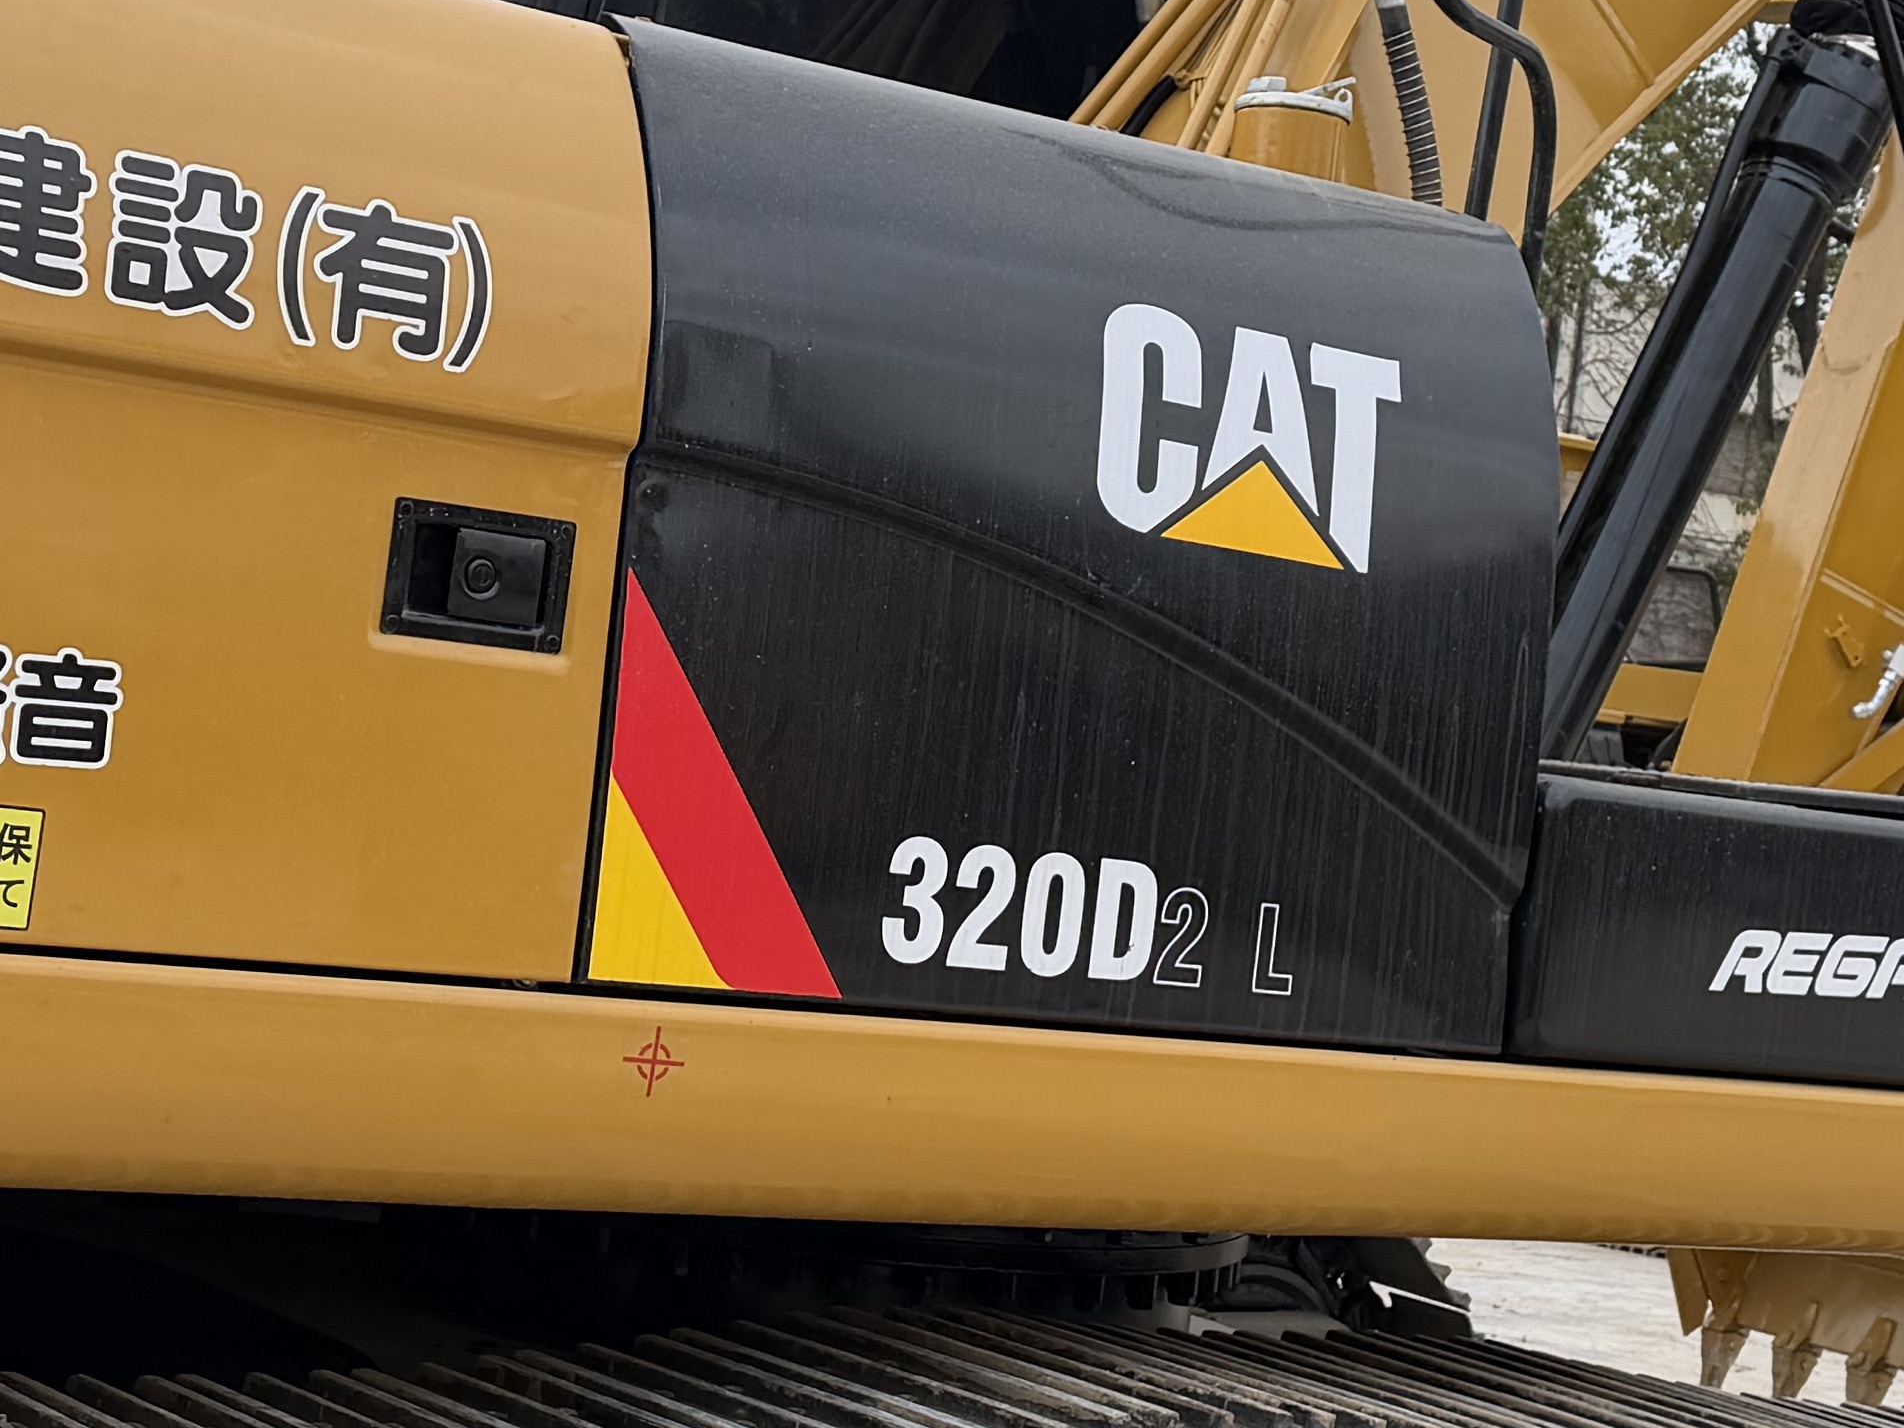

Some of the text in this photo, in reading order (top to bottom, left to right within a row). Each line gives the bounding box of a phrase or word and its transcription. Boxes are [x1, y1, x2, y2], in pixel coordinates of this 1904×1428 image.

[1097, 303, 1402, 574] CAT
[881, 835, 1293, 996] 320D2 L
